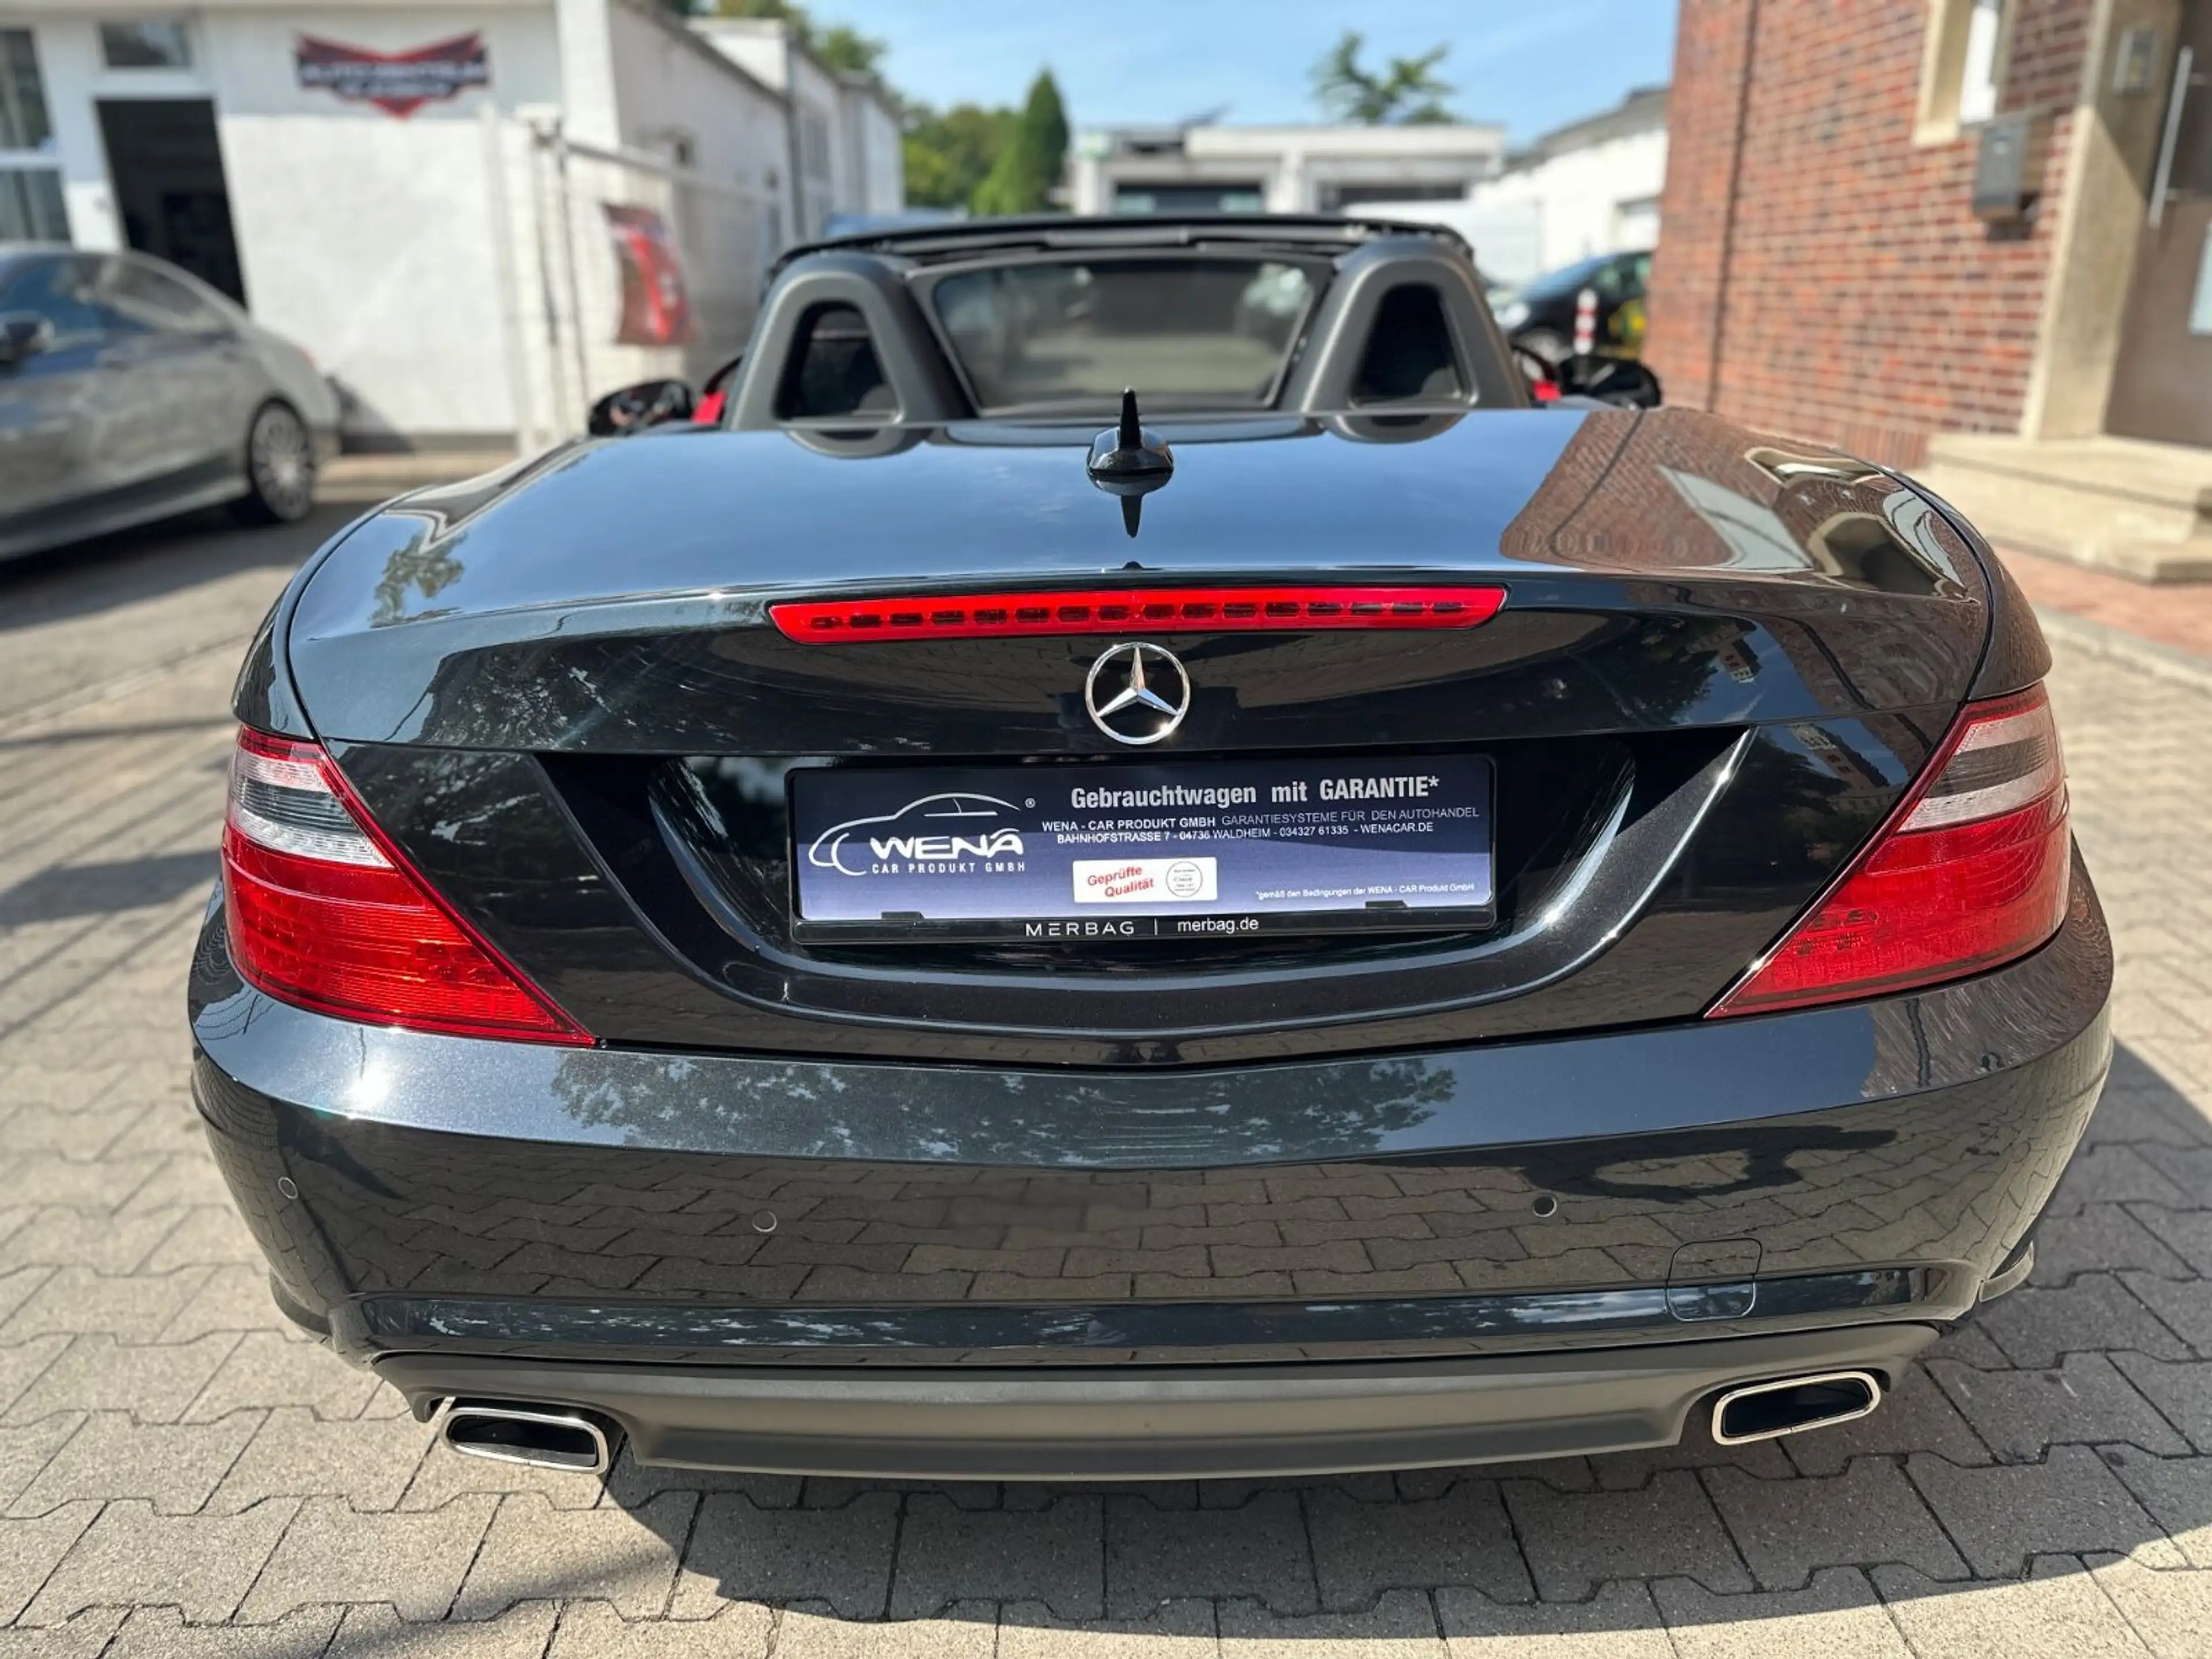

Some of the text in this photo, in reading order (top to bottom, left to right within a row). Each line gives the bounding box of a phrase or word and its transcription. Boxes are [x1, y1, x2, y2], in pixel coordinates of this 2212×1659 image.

[1070, 785, 1256, 809] Gebrauchtwagen
[1271, 781, 1308, 802] mit
[1042, 821, 1078, 832] WENA
[1088, 821, 1114, 831] CAR
[1118, 819, 1176, 830] PRODUKT
[1179, 817, 1216, 828] GMBH
[1222, 814, 1338, 825] GARANTIESYSTEME
[1340, 810, 1366, 823] FÜR
[1370, 810, 1396, 821] DEN
[1398, 807, 1479, 819] AUTOHANDEL
[1057, 832, 1161, 844] BAHNHOFSTRASSE
[1165, 831, 1171, 840] 7
[1212, 828, 1270, 839] WALDHEIM
[1279, 827, 1315, 837] 034327
[1319, 825, 1349, 835] 61335
[1360, 822, 1434, 834] WENACAR.DE
[870, 828, 1024, 859] WENA
[872, 862, 1025, 873] CAR PRODUKT GMBH
[1088, 866, 1143, 886] Geprüfte
[1104, 878, 1155, 897] Qualität
[1302, 887, 1351, 897] Bedingungen
[1368, 885, 1392, 895] WENA
[1399, 885, 1418, 893] CAR
[1419, 884, 1448, 892] Produkt
[1450, 882, 1475, 892] GmbH
[1025, 916, 1259, 936] MERBAG merbag.de
